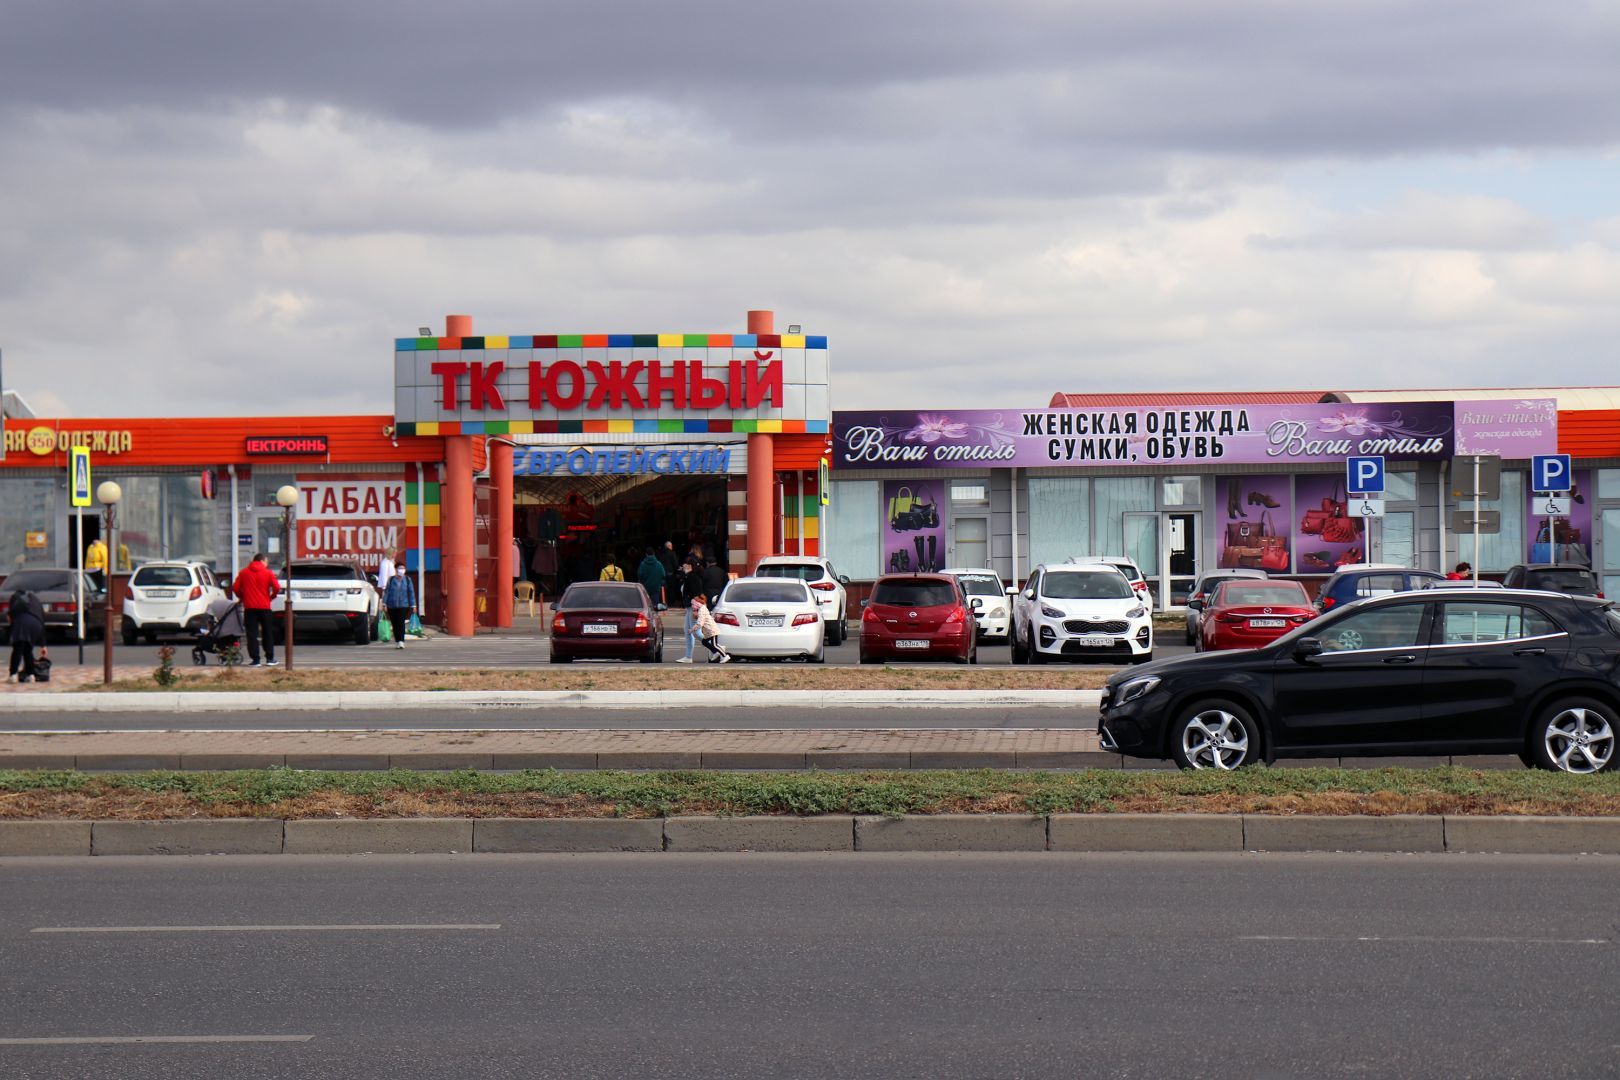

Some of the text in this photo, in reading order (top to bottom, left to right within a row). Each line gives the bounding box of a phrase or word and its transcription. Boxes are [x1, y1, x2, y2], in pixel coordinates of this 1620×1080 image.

[431, 351, 783, 411] ТК ЮЖНЫЙ
[1022, 410, 1251, 437] ЖЕНСКАЯ ОДЕЖДА
[58, 430, 132, 454] ОДЕЖДА
[844, 426, 1017, 462] Ваш стиль
[1048, 436, 1225, 462] СУМКИ, ОБУВЬ
[1266, 419, 1445, 456] Ваш стиль
[300, 486, 402, 514] ТАБАК
[305, 526, 397, 550] ОПТОМ
